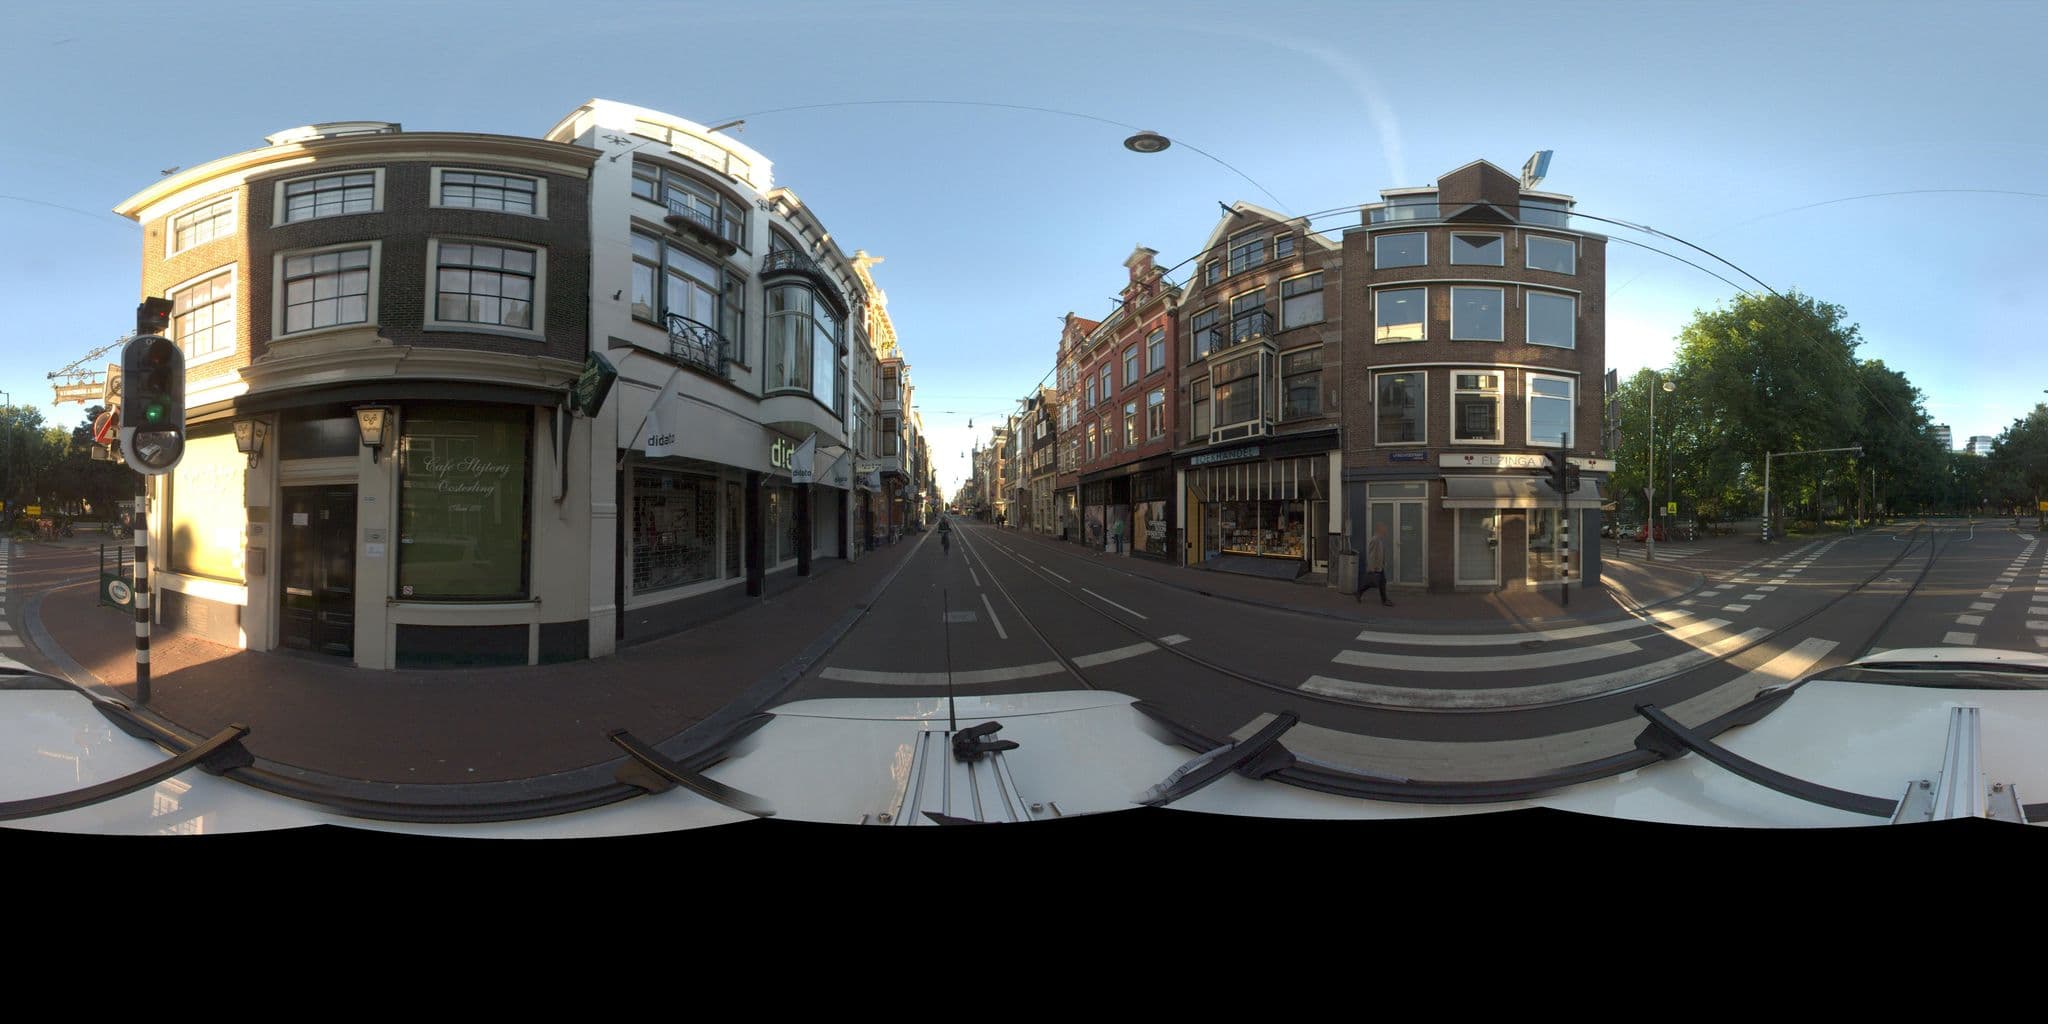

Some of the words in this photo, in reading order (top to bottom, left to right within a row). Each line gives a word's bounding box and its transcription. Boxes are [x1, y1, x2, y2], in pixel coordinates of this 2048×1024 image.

[771, 438, 794, 470] did
[1481, 456, 1534, 467] ELZINGA
[438, 480, 495, 497] Oosterling
